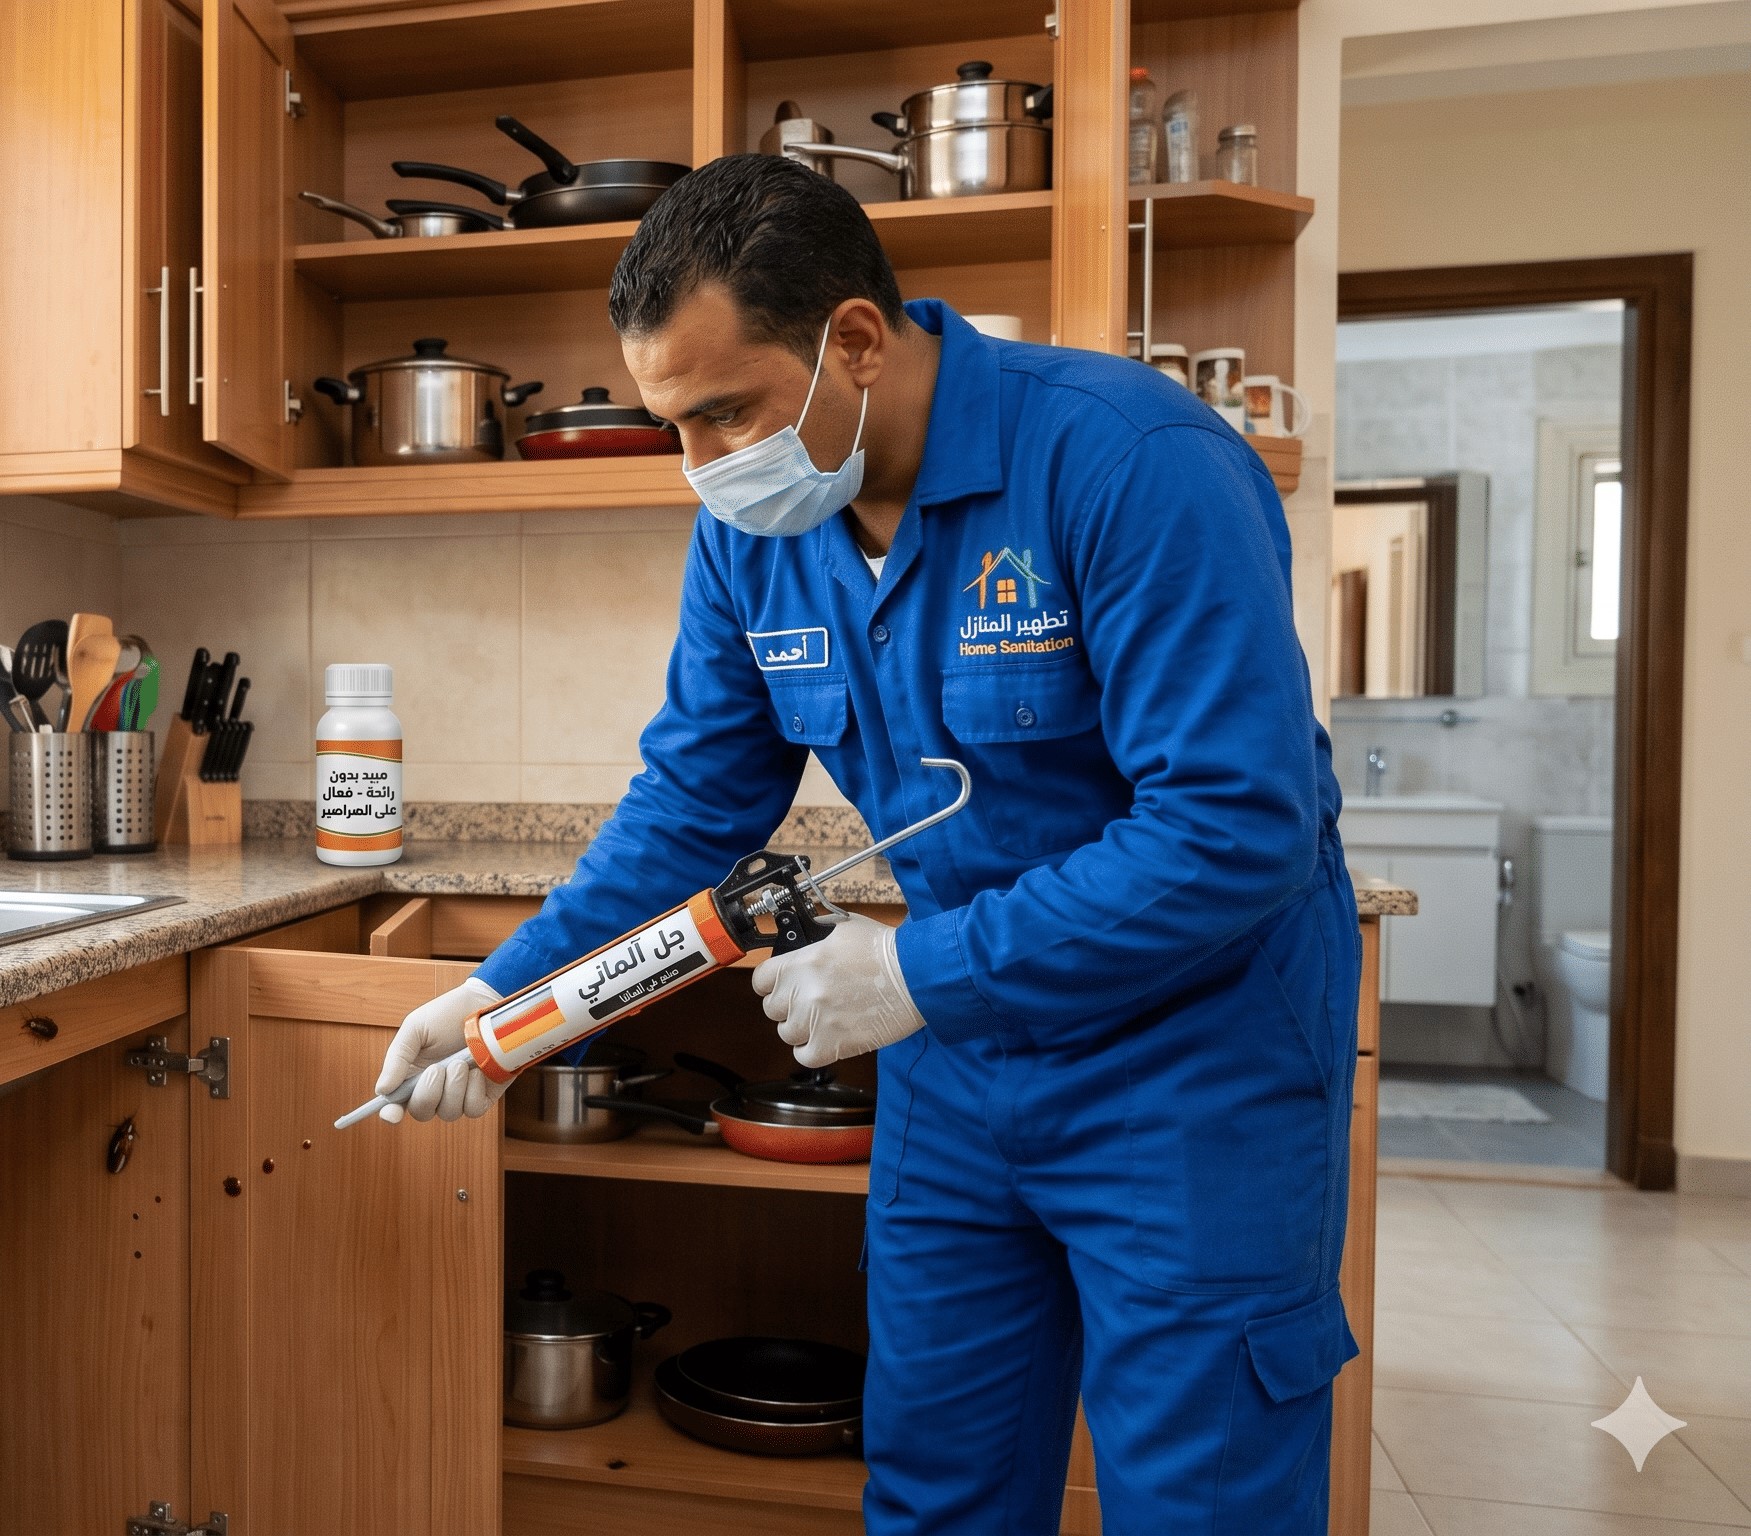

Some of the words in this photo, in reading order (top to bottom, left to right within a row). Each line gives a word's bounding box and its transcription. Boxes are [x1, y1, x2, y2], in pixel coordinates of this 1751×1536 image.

[960, 613, 1011, 640] المنازل
[1015, 609, 1069, 637] تطهير
[766, 634, 808, 663] أحمد
[959, 642, 997, 656] Home
[1000, 636, 1074, 654] Sanitation
[329, 770, 359, 784] بدون
[362, 772, 388, 784] مبيد
[322, 785, 353, 801] فعال
[366, 785, 395, 801] رائحة
[321, 803, 372, 819] الصراصير
[374, 803, 397, 819] على
[653, 929, 685, 960] جل
